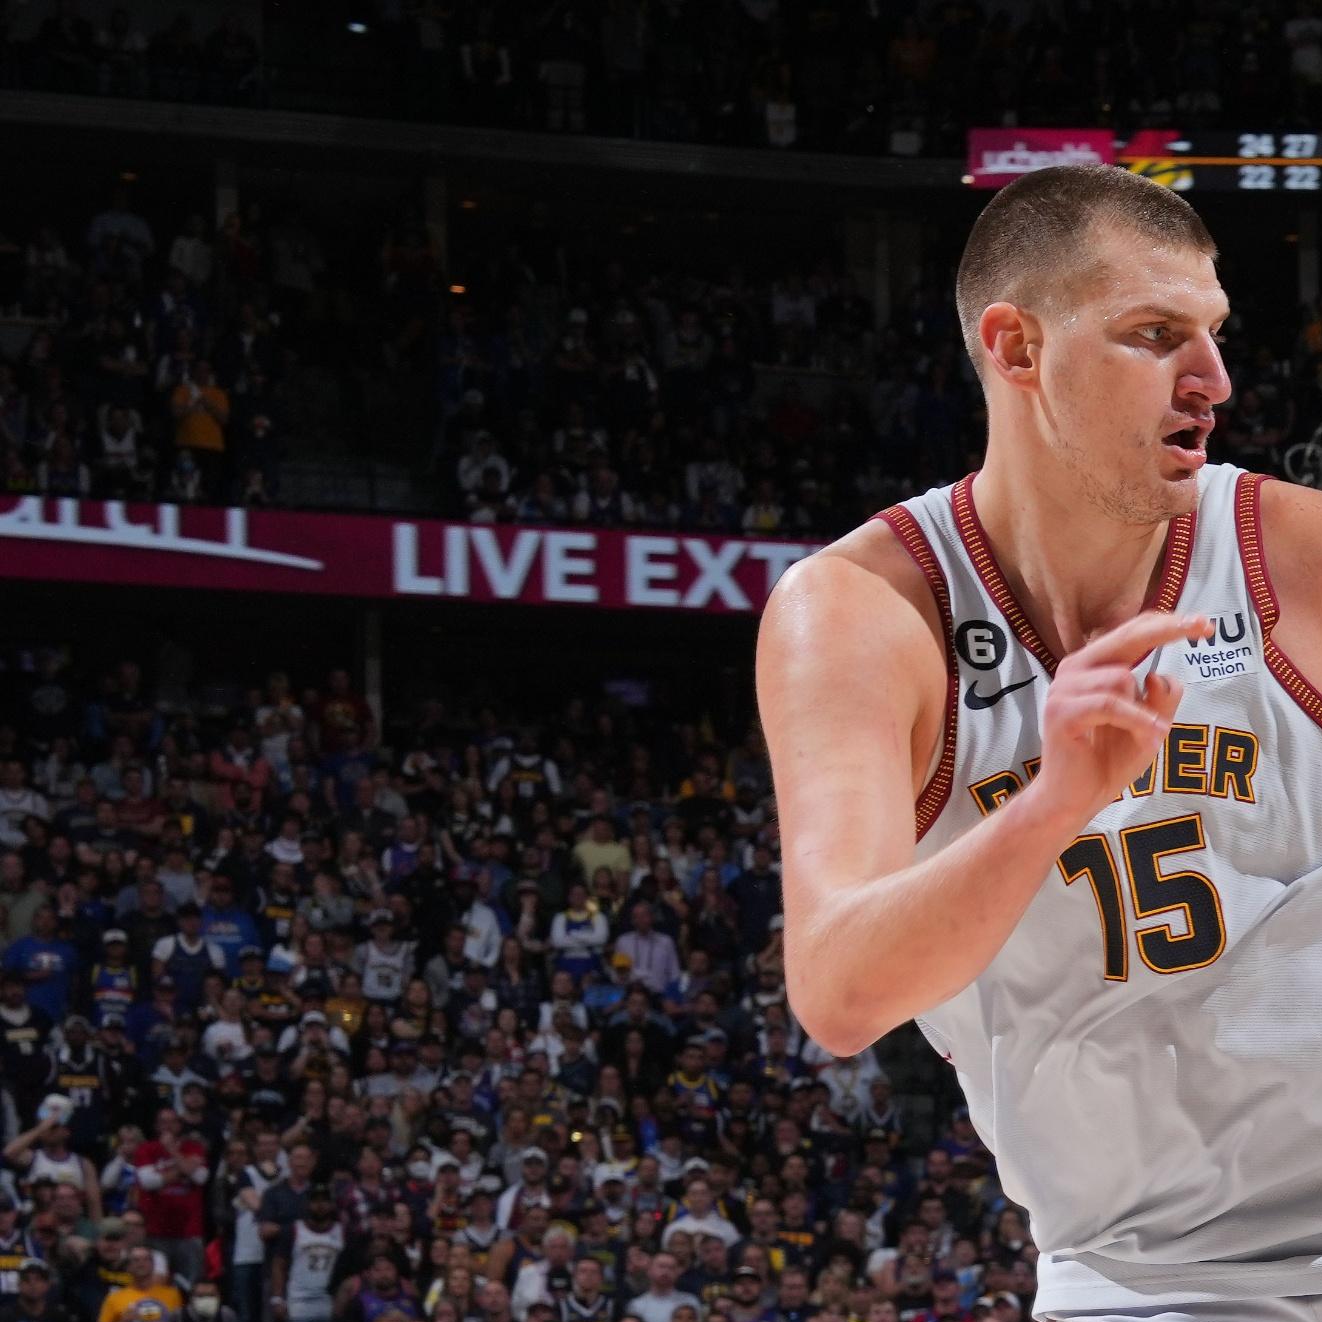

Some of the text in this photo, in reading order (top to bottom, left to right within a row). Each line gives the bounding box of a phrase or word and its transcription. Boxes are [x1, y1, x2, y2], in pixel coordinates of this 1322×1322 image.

[1281, 133, 1318, 159] 27
[1238, 165, 1276, 190] 22
[1284, 165, 1321, 190] 22
[392, 523, 822, 609] LIVE EXT
[965, 627, 998, 665] 6
[1184, 646, 1252, 666] Western
[1200, 662, 1246, 679] Union
[1056, 813, 1227, 983] 15
